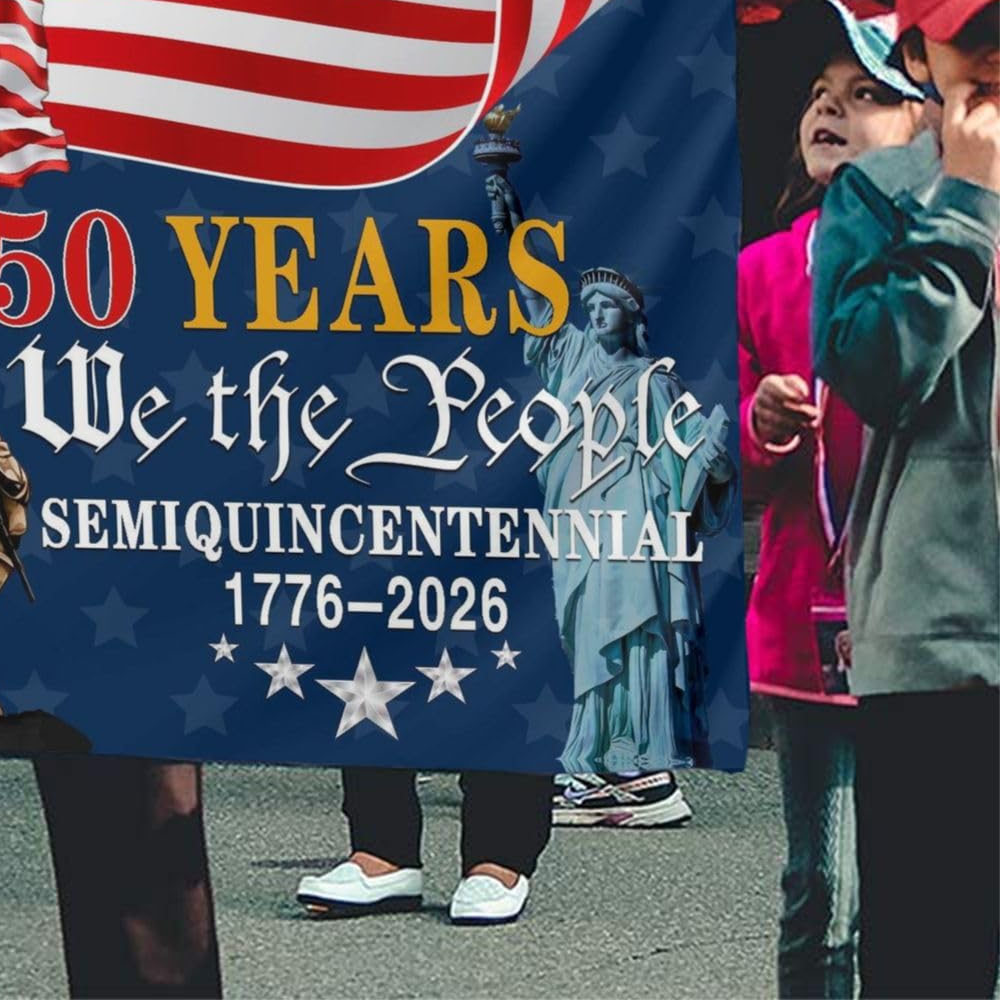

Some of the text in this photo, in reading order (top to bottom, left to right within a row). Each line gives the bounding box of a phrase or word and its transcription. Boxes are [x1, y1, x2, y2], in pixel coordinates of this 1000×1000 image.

[164, 215, 570, 338] YEARS
[5, 333, 706, 503] We the People
[40, 496, 704, 564] SEMIQUINCENTENNIAL
